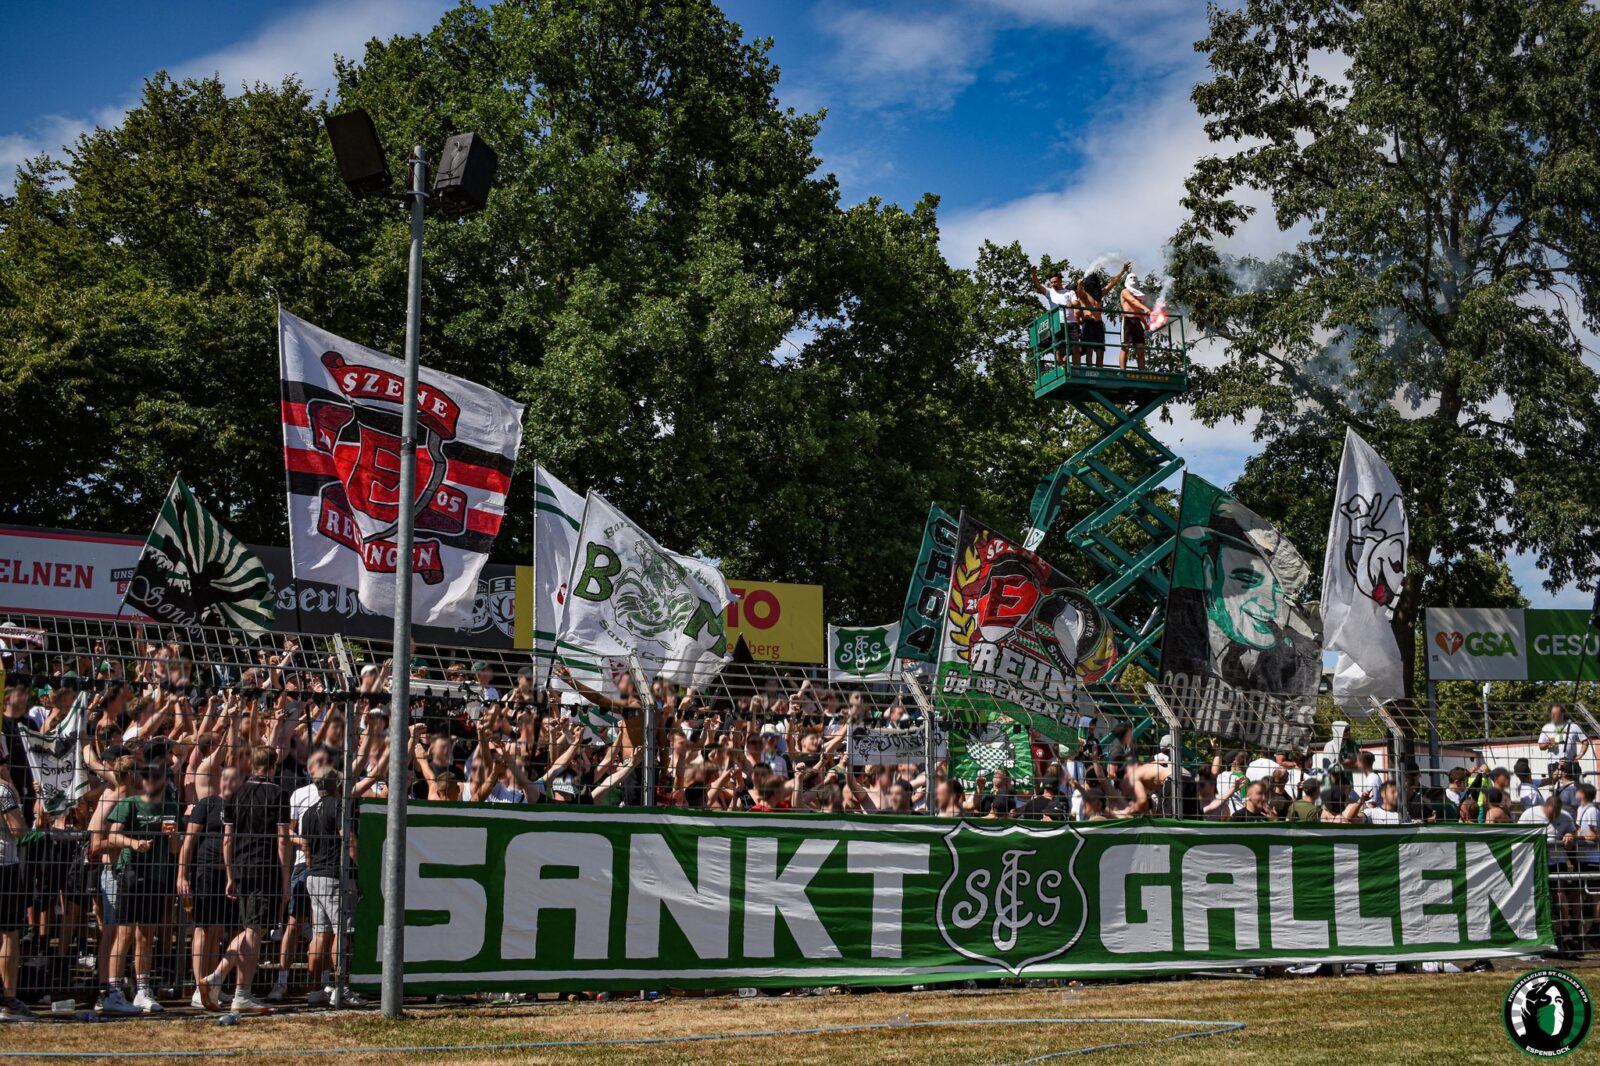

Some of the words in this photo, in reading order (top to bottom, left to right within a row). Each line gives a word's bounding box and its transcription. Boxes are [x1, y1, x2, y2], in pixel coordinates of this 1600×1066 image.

[1464, 631, 1519, 657] GSA
[376, 826, 931, 962] SANKT
[1099, 841, 1539, 955] GALLEN
